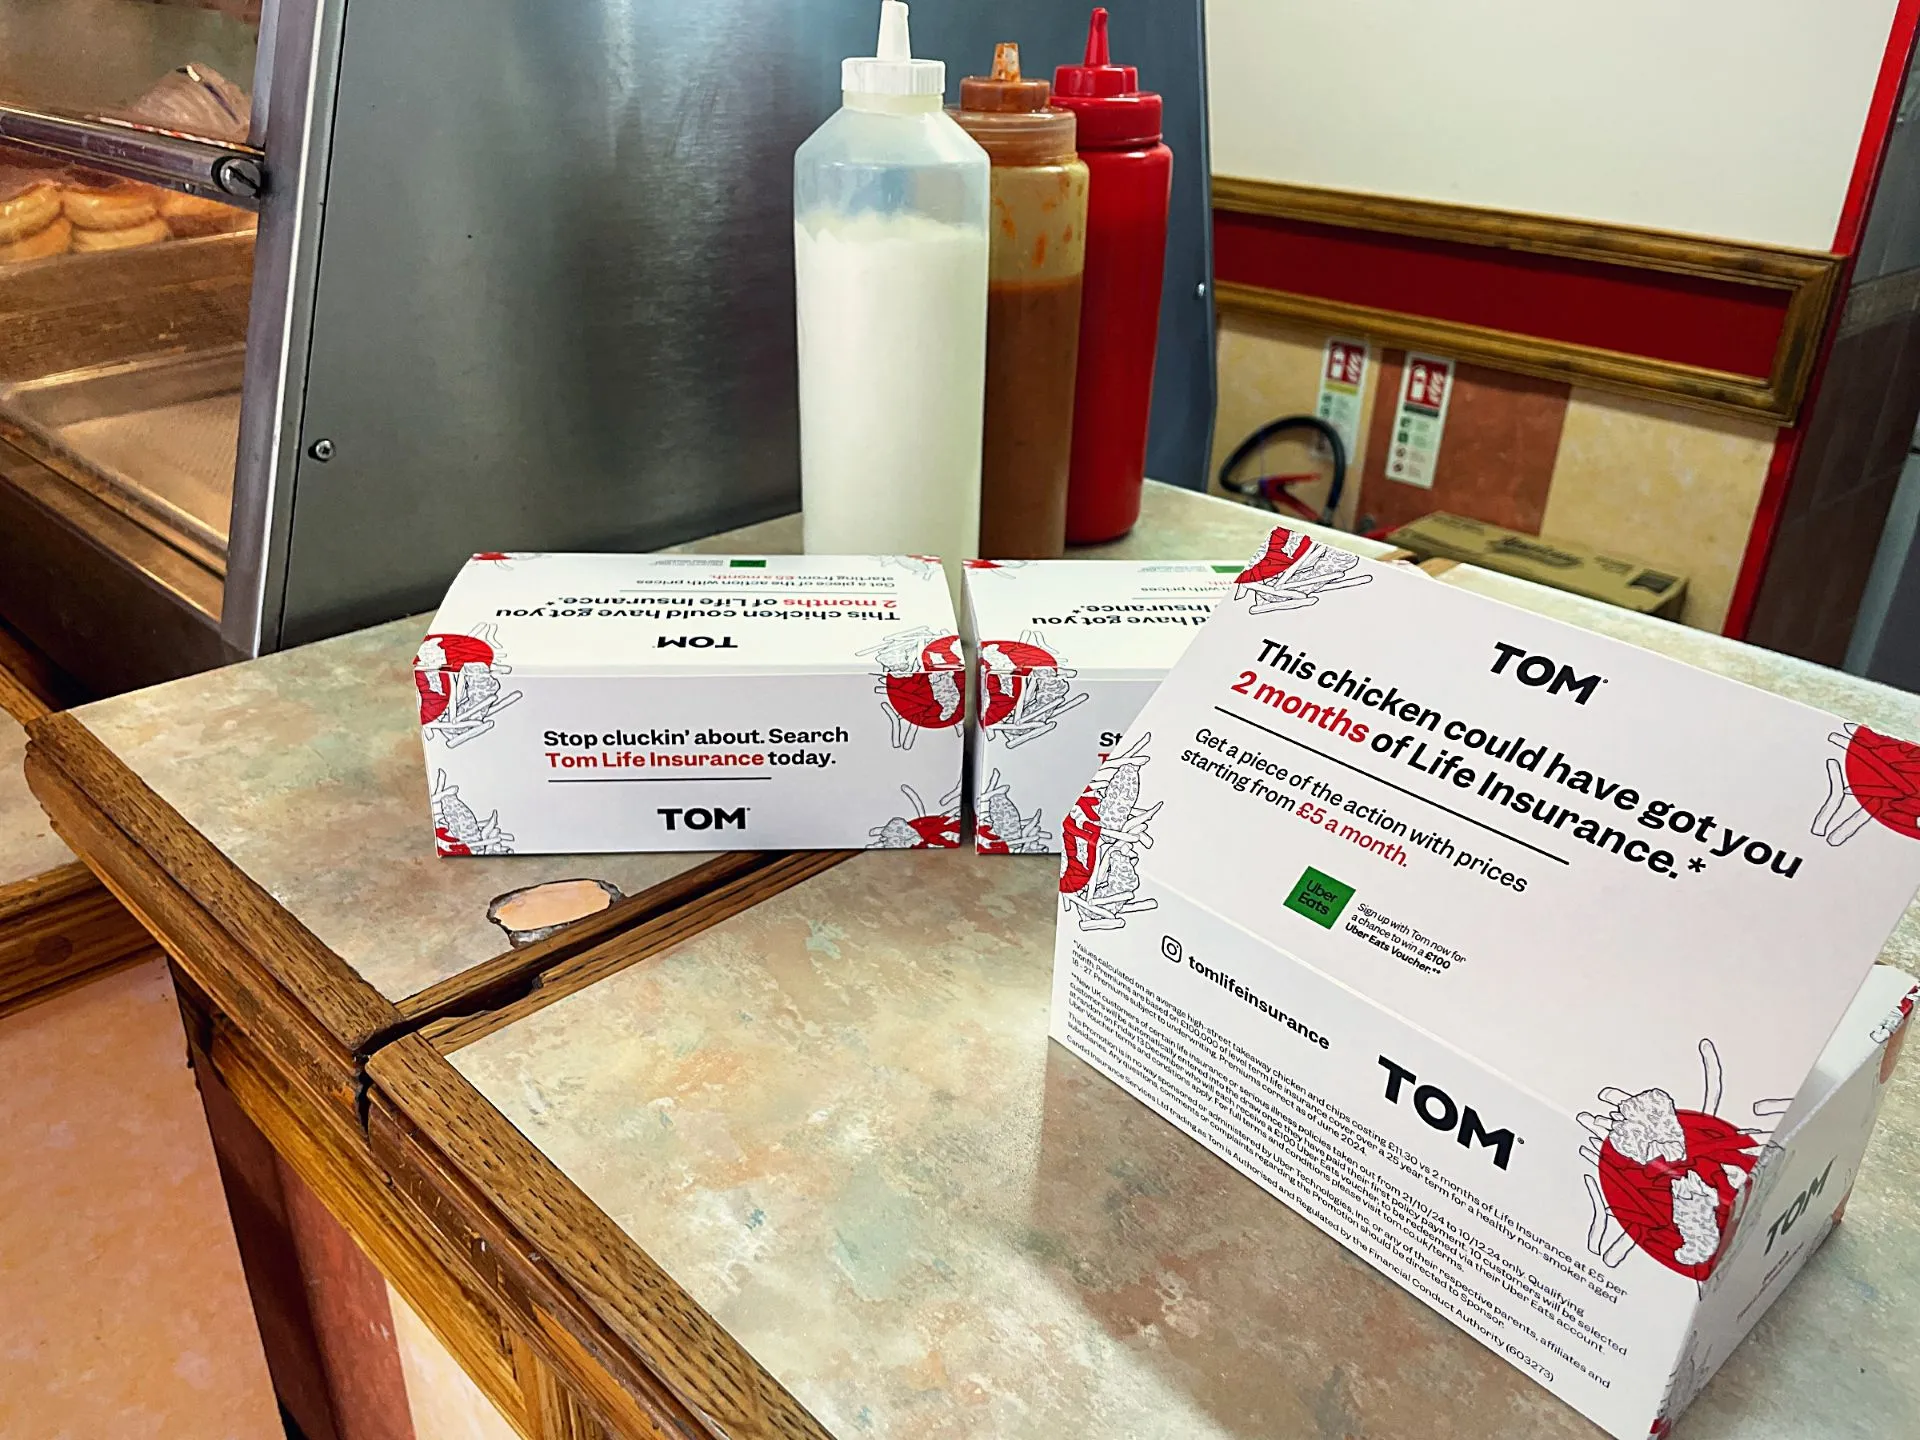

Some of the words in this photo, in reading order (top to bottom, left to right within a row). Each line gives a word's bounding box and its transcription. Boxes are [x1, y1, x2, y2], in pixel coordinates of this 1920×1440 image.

[495, 607, 546, 617] you
[549, 608, 593, 618] got
[597, 609, 660, 619] have
[699, 598, 746, 607] Life
[753, 598, 777, 607] of
[783, 599, 876, 607] months
[883, 600, 896, 608] 2
[666, 610, 737, 619] could
[743, 610, 842, 620] chicken
[847, 611, 900, 621] This
[1032, 615, 1079, 625] you
[1081, 615, 1121, 626] got
[1128, 616, 1188, 626] have
[657, 636, 738, 648] TOM
[1490, 641, 1602, 705] TOM
[544, 730, 598, 749] Stop
[694, 728, 765, 745] about.
[768, 726, 848, 744] Search
[1230, 670, 1257, 695] 2
[1253, 683, 1369, 743] months
[1371, 733, 1415, 759] of
[1407, 742, 1475, 788] Life
[545, 752, 598, 768] Tom
[602, 751, 645, 767] Life
[650, 752, 764, 766] Insurance
[767, 749, 836, 768] today.
[1257, 638, 1316, 680] This
[1317, 669, 1441, 732] chicken
[1443, 721, 1548, 772] could
[1543, 752, 1640, 810] have
[1637, 800, 1717, 843] got
[1709, 828, 1803, 879] you
[657, 807, 746, 830] TOM
[1180, 749, 1252, 792] starting
[1249, 778, 1296, 812] from
[1295, 802, 1327, 824] £5
[1324, 819, 1338, 833] a
[1339, 825, 1407, 867] month.
[1195, 728, 1228, 753] Get
[1225, 745, 1239, 759] a
[1236, 750, 1288, 781] piece
[1289, 774, 1314, 790] of
[1310, 781, 1343, 806] the
[1343, 800, 1407, 837] action
[1409, 828, 1455, 859] with
[1453, 851, 1527, 892] prices
[1306, 880, 1338, 903] Uber
[1298, 892, 1330, 916] Eats
[1345, 922, 1369, 939] Uber
[1368, 934, 1390, 951] Eats
[1357, 903, 1377, 918] Sign
[1377, 914, 1390, 925] up
[1390, 920, 1410, 935] with
[1411, 928, 1430, 946] Tom
[1430, 942, 1451, 956] now
[1450, 950, 1466, 963] for
[1357, 917, 1391, 938] chance
[1390, 933, 1401, 944] to
[1401, 939, 1417, 952] win
[1424, 951, 1451, 969] £100
[1188, 956, 1329, 1049] tomlifeinsurance
[1069, 998, 1085, 1013] Uber
[1086, 1010, 1114, 1033] Voucher
[1115, 1030, 1136, 1050] terms
[1136, 1046, 1151, 1060] and
[1151, 1057, 1190, 1086] conditions
[1214, 1097, 1228, 1111] For
[1229, 1107, 1242, 1121] full
[1242, 1117, 1267, 1138] terms
[1268, 1135, 1285, 1150] and
[1285, 1147, 1330, 1182] conditions
[1331, 1178, 1361, 1202] please
[1362, 1198, 1381, 1217] visit
[1378, 1054, 1516, 1171] TOM
[1097, 958, 1134, 985] calculated
[1155, 995, 1186, 1018] average
[1187, 1013, 1231, 1047] high-street
[1232, 1043, 1272, 1073] takeaway
[1272, 1069, 1306, 1095] chicken
[1307, 1092, 1325, 1107] and
[1325, 1103, 1350, 1123] chips
[1351, 1120, 1386, 1147] costing
[1440, 1176, 1480, 1206] months
[1493, 1208, 1514, 1227] Life
[1515, 1222, 1572, 1263] Insurance
[1605, 1280, 1627, 1296] per
[1108, 1050, 1122, 1064] Any
[1159, 1086, 1199, 1117] comments
[1209, 1121, 1254, 1155] complaints
[1254, 1152, 1296, 1186] regarding
[1296, 1180, 1311, 1195] the
[1312, 1190, 1359, 1228] Promotion
[1360, 1225, 1391, 1250] should
[1405, 1256, 1447, 1289] directed
[1066, 1034, 1090, 1055] Candid
[1090, 1051, 1125, 1080] Insurance
[1125, 1076, 1156, 1102] Services
[1156, 1098, 1169, 1111] Ltd
[1169, 1107, 1197, 1133] trading
[1208, 1133, 1224, 1150] Tom
[1232, 1152, 1278, 1188] Authorised
[1278, 1185, 1295, 1200] and
[1296, 1196, 1339, 1231] Regulated
[1352, 1236, 1368, 1251] the
[1368, 1247, 1411, 1281] Financial
[1412, 1278, 1454, 1312] Conduct
[1455, 1309, 1505, 1347] Authority
[1505, 1343, 1554, 1382] (603273)
[1764, 1158, 1834, 1256] TOM
